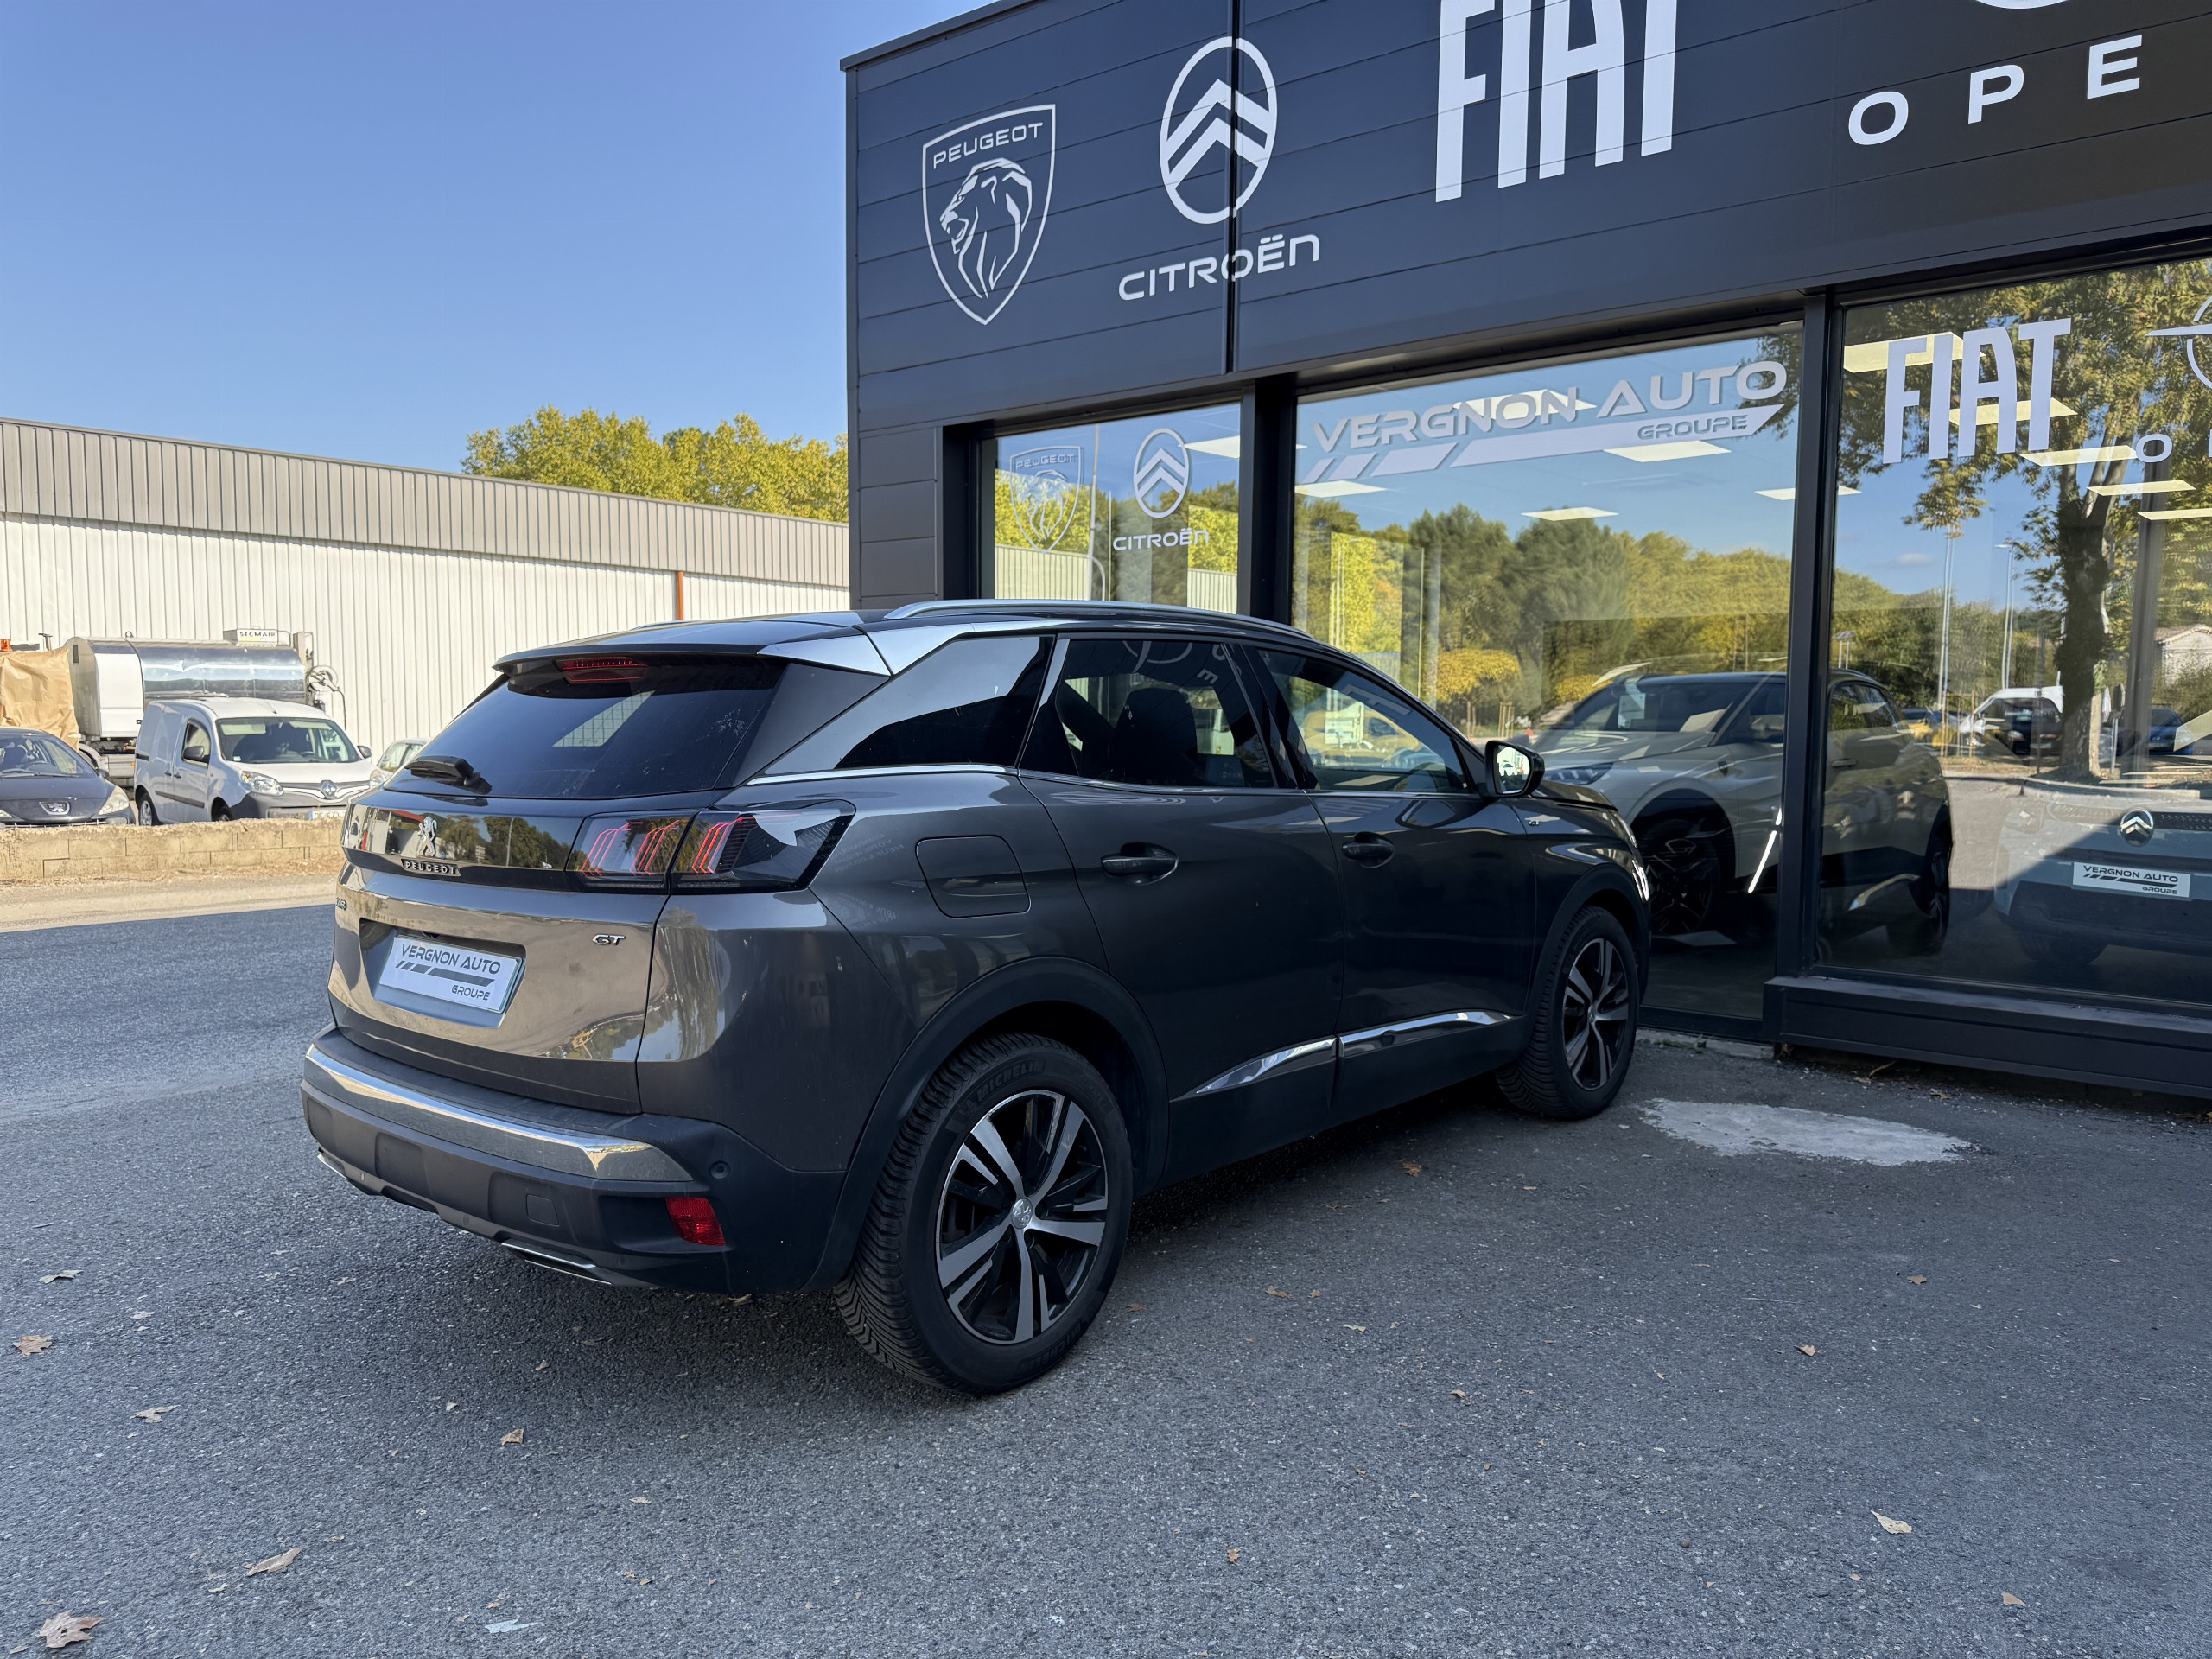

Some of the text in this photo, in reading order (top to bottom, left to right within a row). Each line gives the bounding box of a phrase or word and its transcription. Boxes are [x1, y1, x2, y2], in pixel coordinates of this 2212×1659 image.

[933, 122, 1044, 169] PEUGEOT
[1883, 318, 2071, 464] FIAT
[1310, 360, 1787, 452] VERGNON AUTO
[1637, 414, 1748, 441] GROUPE
[1015, 454, 1076, 469] PEUGEOT
[1113, 528, 1210, 551] CITROËN
[404, 861, 458, 875] PEUGEOT
[2083, 865, 2179, 883] VERGNON AUTO
[2142, 886, 2177, 895] GROUPE
[593, 934, 626, 946] GT
[400, 943, 501, 976] VERGNON AUTO
[451, 984, 491, 1001] GROUPE
